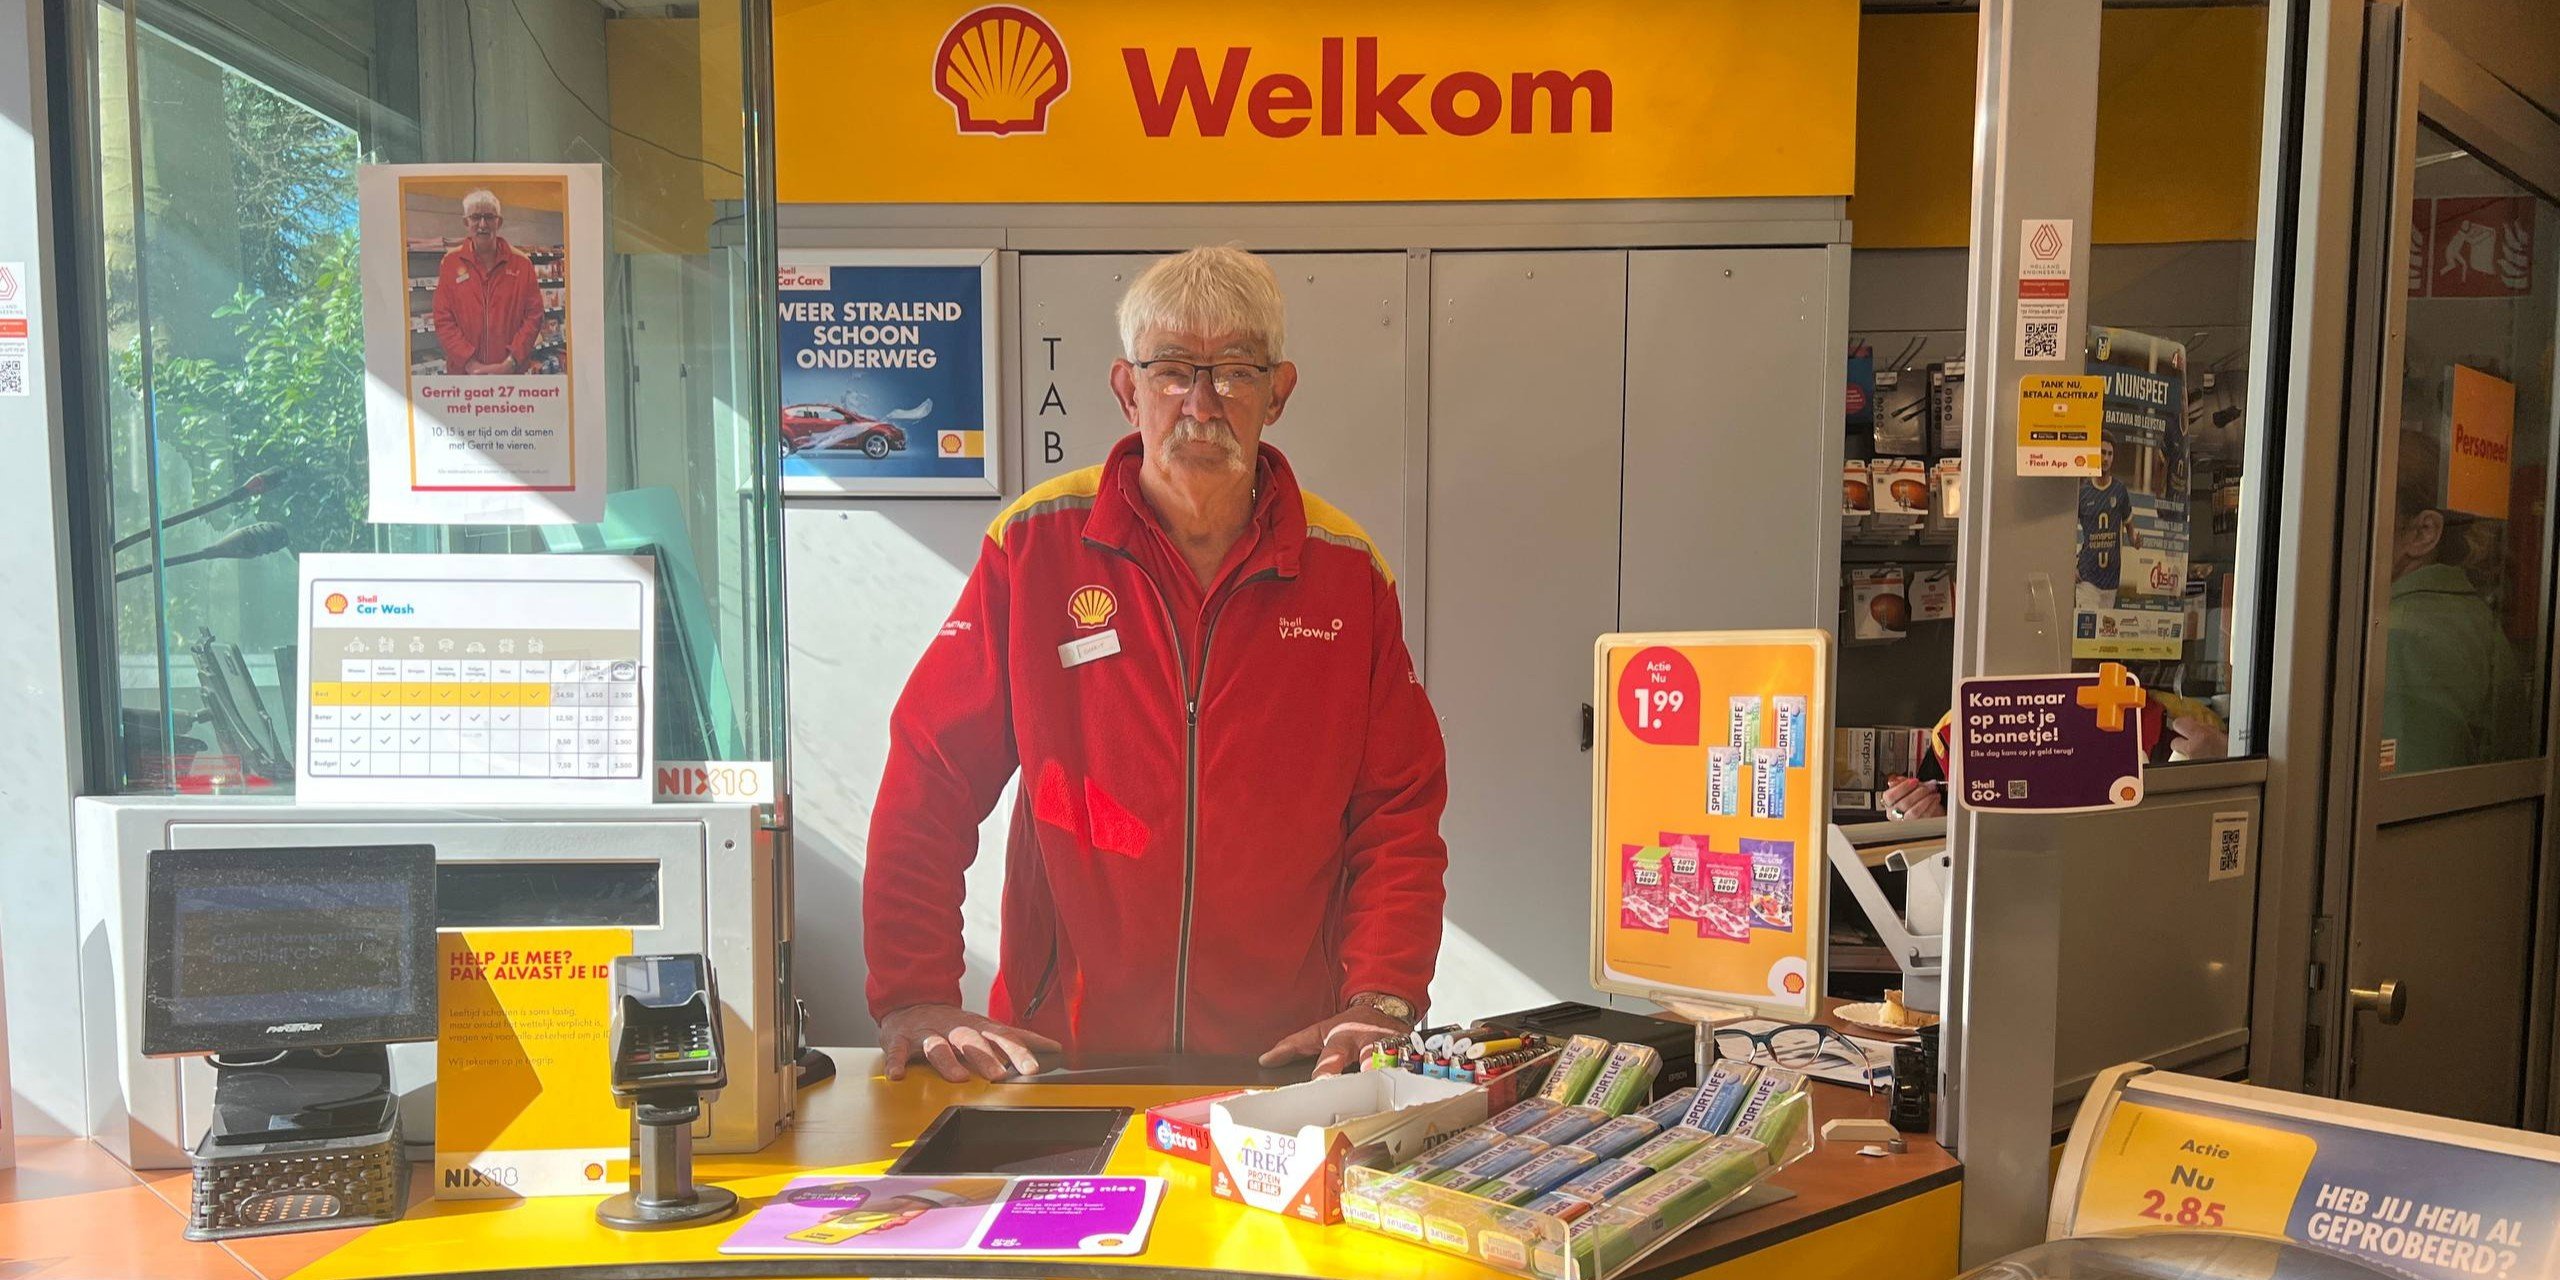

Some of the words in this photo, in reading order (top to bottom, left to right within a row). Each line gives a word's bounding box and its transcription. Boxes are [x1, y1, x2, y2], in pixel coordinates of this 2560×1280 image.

[1121, 36, 1613, 138] Welkom
[798, 276, 824, 286] Care
[779, 302, 836, 322] WEER
[843, 302, 962, 322] STRALEND
[813, 325, 920, 346] SCHOON
[796, 348, 938, 370] ONDERWEG
[422, 386, 461, 399] Gerrit
[464, 386, 495, 401] gaat
[498, 386, 515, 398] 27
[518, 385, 561, 398] maart
[2041, 380, 2064, 390] TANK
[2066, 380, 2083, 391] NU,
[2115, 372, 2170, 406] NUNSPEET
[2022, 390, 2054, 400] BETAAL
[2056, 390, 2099, 400] ACHTERAF
[447, 402, 472, 414] met
[475, 401, 535, 417] pensioen
[458, 426, 465, 437] is
[467, 428, 477, 437] er
[478, 427, 493, 440] tijd
[494, 428, 509, 437] om
[511, 426, 523, 437] dit
[524, 428, 554, 438] samen
[448, 441, 466, 451] met
[467, 440, 494, 451] Gerrit
[496, 441, 505, 451] te
[2455, 423, 2510, 465] Personeel
[2051, 460, 2069, 468] App
[357, 595, 378, 604] Shell
[357, 604, 378, 615] Car
[381, 604, 415, 615] Wash
[1279, 616, 1302, 627] Shell
[1279, 626, 1338, 641] V-Power
[1646, 661, 1672, 672] Actie
[1651, 673, 1668, 684] Nu
[1970, 692, 2012, 708] Kom
[2016, 693, 2066, 706] maar
[1969, 714, 1994, 730] op
[1999, 710, 2035, 725] met
[2038, 708, 2057, 728] je
[1970, 726, 2059, 747] bonnetje!
[1861, 730, 1873, 779] Strepsils
[1971, 750, 1985, 758] Elke
[1986, 749, 2001, 759] dag
[2018, 750, 2028, 758] op
[2037, 748, 2053, 757] geld
[658, 768, 758, 796] NIX18
[1711, 755, 1722, 812] SPORTLIFE
[1756, 758, 1767, 815] SPORTLIFE
[1972, 780, 1995, 790] Shell
[1972, 789, 2001, 801] GO+
[450, 951, 496, 967] HELP
[501, 950, 520, 966] JE
[526, 950, 573, 966] MEE?
[450, 967, 487, 981] PAK
[494, 965, 563, 981] ALVAST
[568, 964, 587, 979] JE
[593, 964, 609, 979] ID
[529, 1008, 550, 1017] soms
[556, 1018, 593, 1030] verplicht
[534, 1029, 576, 1041] zekerheid
[1541, 1046, 1580, 1099] SPORTLIFE
[1588, 1053, 1627, 1107] SPORTLIFE
[1686, 1070, 1727, 1127] SPORTLIFE
[1733, 1077, 1777, 1137] SPORTLIFE
[1156, 1123, 1198, 1152] extra
[2180, 1138, 2231, 1160] Actie
[1242, 1148, 1289, 1176] TREK
[445, 1167, 519, 1189] NIX18
[1247, 1169, 1281, 1185] PROTEIN
[2170, 1164, 2215, 1192] Nu
[2138, 1189, 2226, 1228] 2.85
[2315, 1183, 2371, 1215] HEB
[2372, 1195, 2411, 1223] JIJ
[2414, 1204, 2482, 1238] HEM
[2485, 1218, 2523, 1248] AL
[2307, 1211, 2518, 1279] GEPROBEERD?
